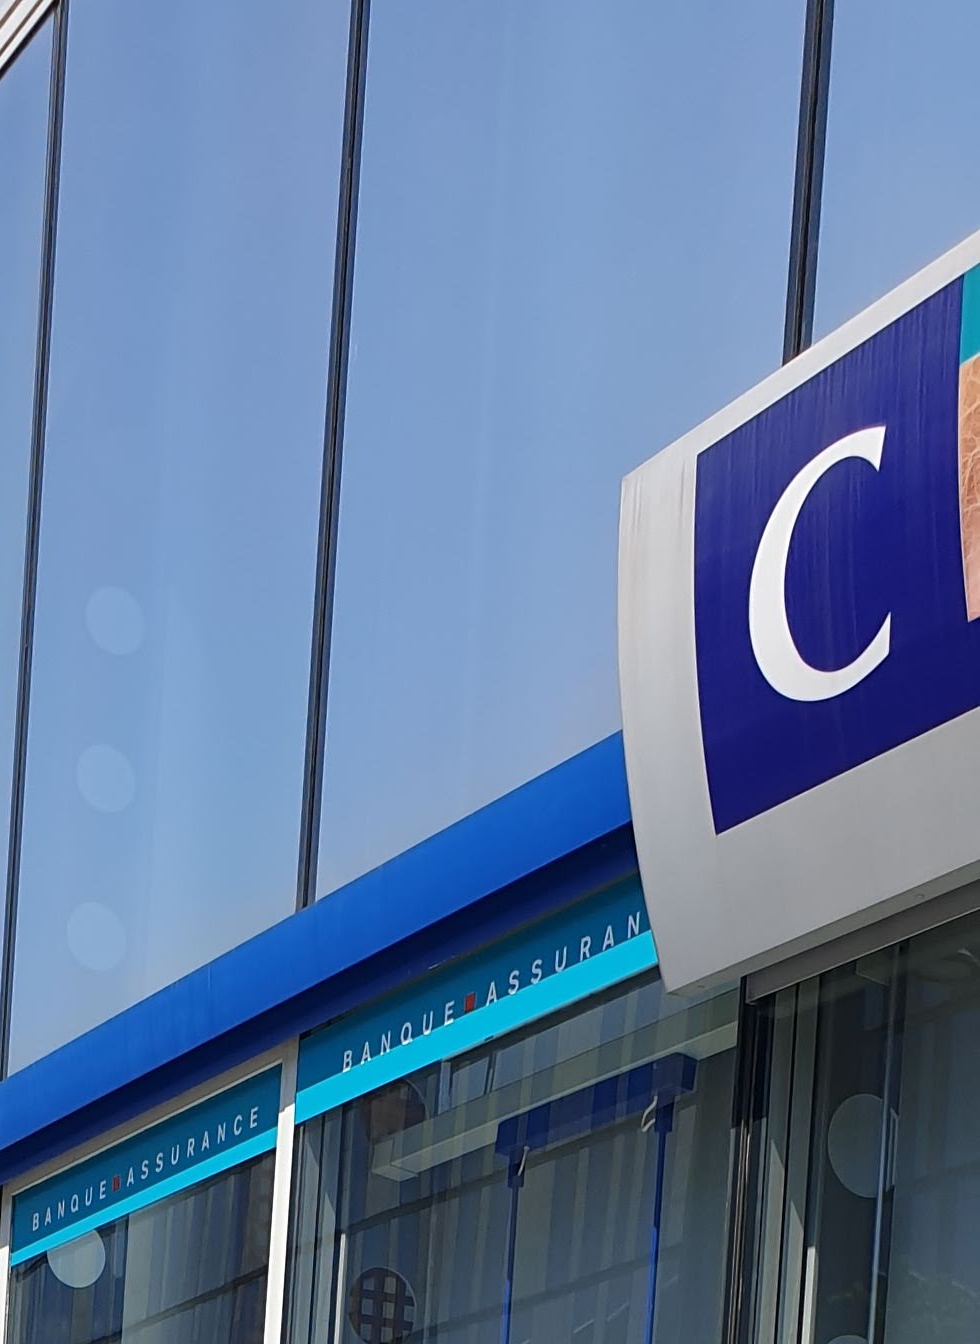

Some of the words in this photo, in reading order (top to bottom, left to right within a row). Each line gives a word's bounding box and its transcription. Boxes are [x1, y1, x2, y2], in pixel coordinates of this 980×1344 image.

[342, 1001, 456, 1074] BANQUE
[485, 911, 642, 1006] ASSURAN
[32, 1180, 107, 1232] BANQUE
[126, 1106, 259, 1187] ASSURANCE
